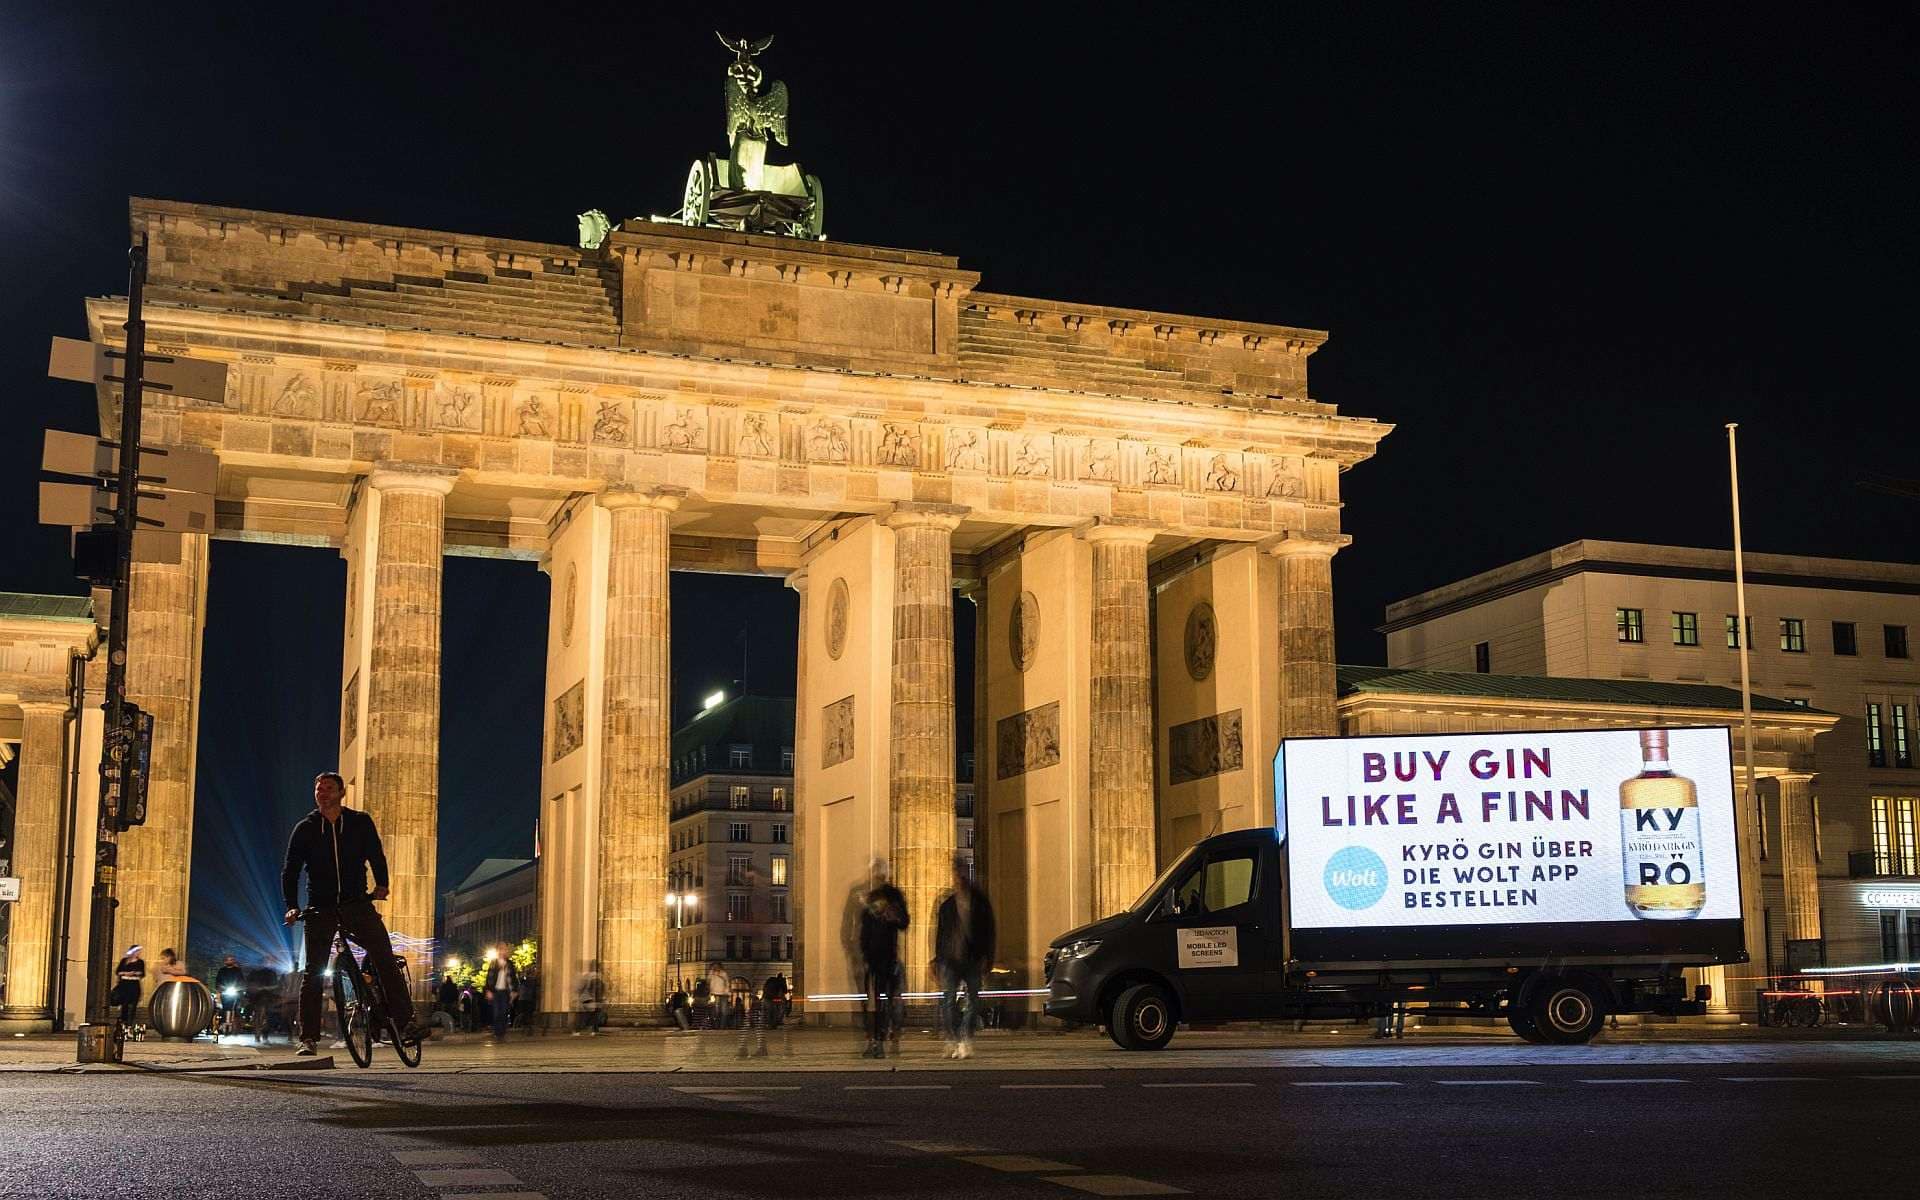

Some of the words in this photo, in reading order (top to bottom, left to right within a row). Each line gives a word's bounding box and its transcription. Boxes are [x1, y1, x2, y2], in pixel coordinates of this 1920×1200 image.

[1363, 750, 1451, 783] BUY
[1468, 748, 1552, 780] GIN
[1321, 793, 1418, 827] LIKE
[1436, 793, 1463, 824] A
[1481, 789, 1590, 823] FINN
[1635, 808, 1685, 832] KY
[1402, 838, 1469, 862] KYRÖ
[1478, 842, 1522, 859] GIN
[1532, 836, 1593, 858] ÜBER
[1332, 868, 1377, 888] Wolt
[1403, 867, 1441, 885] DIE
[1453, 865, 1520, 884] WOLT
[1531, 864, 1579, 882] APP
[1639, 853, 1691, 886] RÖ
[1404, 888, 1537, 909] BESTELLEN
[1191, 949, 1223, 957] SCREENS
